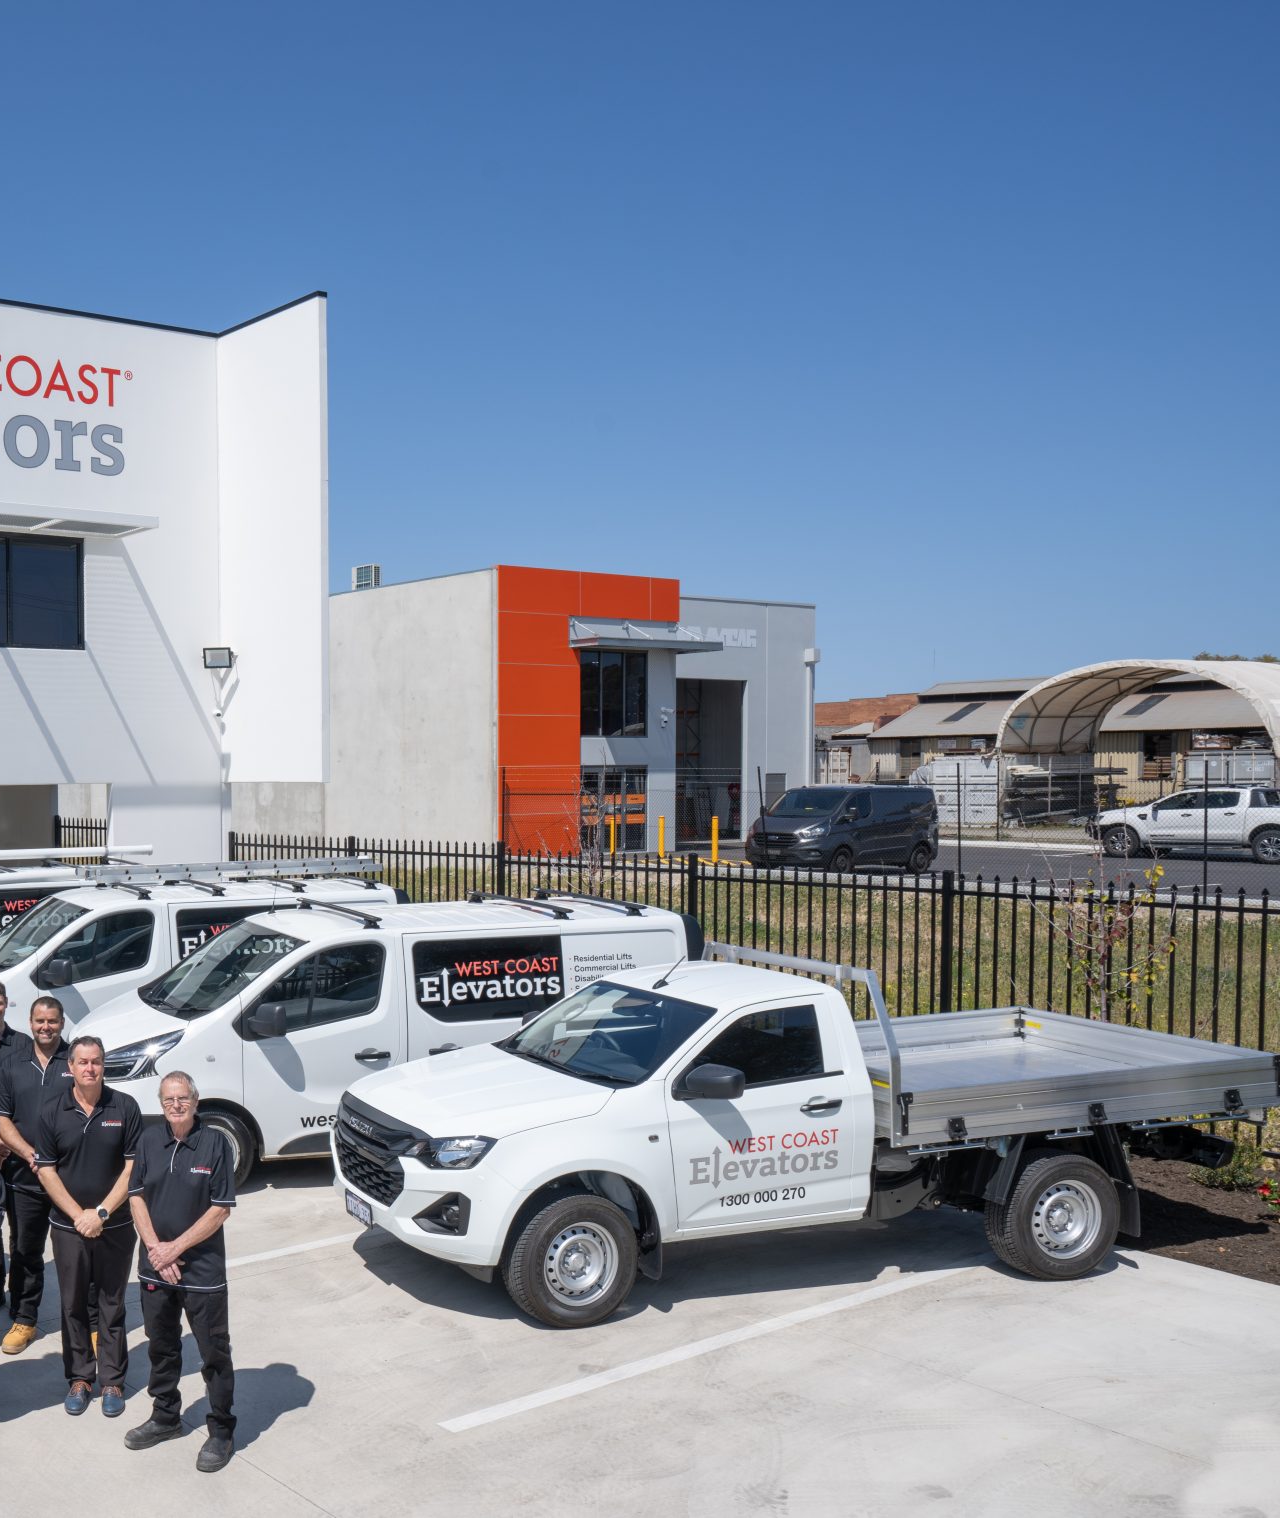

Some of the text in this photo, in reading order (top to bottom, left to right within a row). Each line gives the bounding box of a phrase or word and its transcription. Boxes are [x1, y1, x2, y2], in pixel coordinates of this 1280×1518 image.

[454, 957, 559, 977] WEST COAST
[573, 953, 632, 962] Residential Lifts
[574, 962, 636, 972] Commercial Lifts
[420, 967, 561, 1008] Elevators
[727, 1129, 839, 1154] WEST COAST
[689, 1146, 839, 1189] Elevators
[720, 1186, 806, 1207] 1300 000 270
